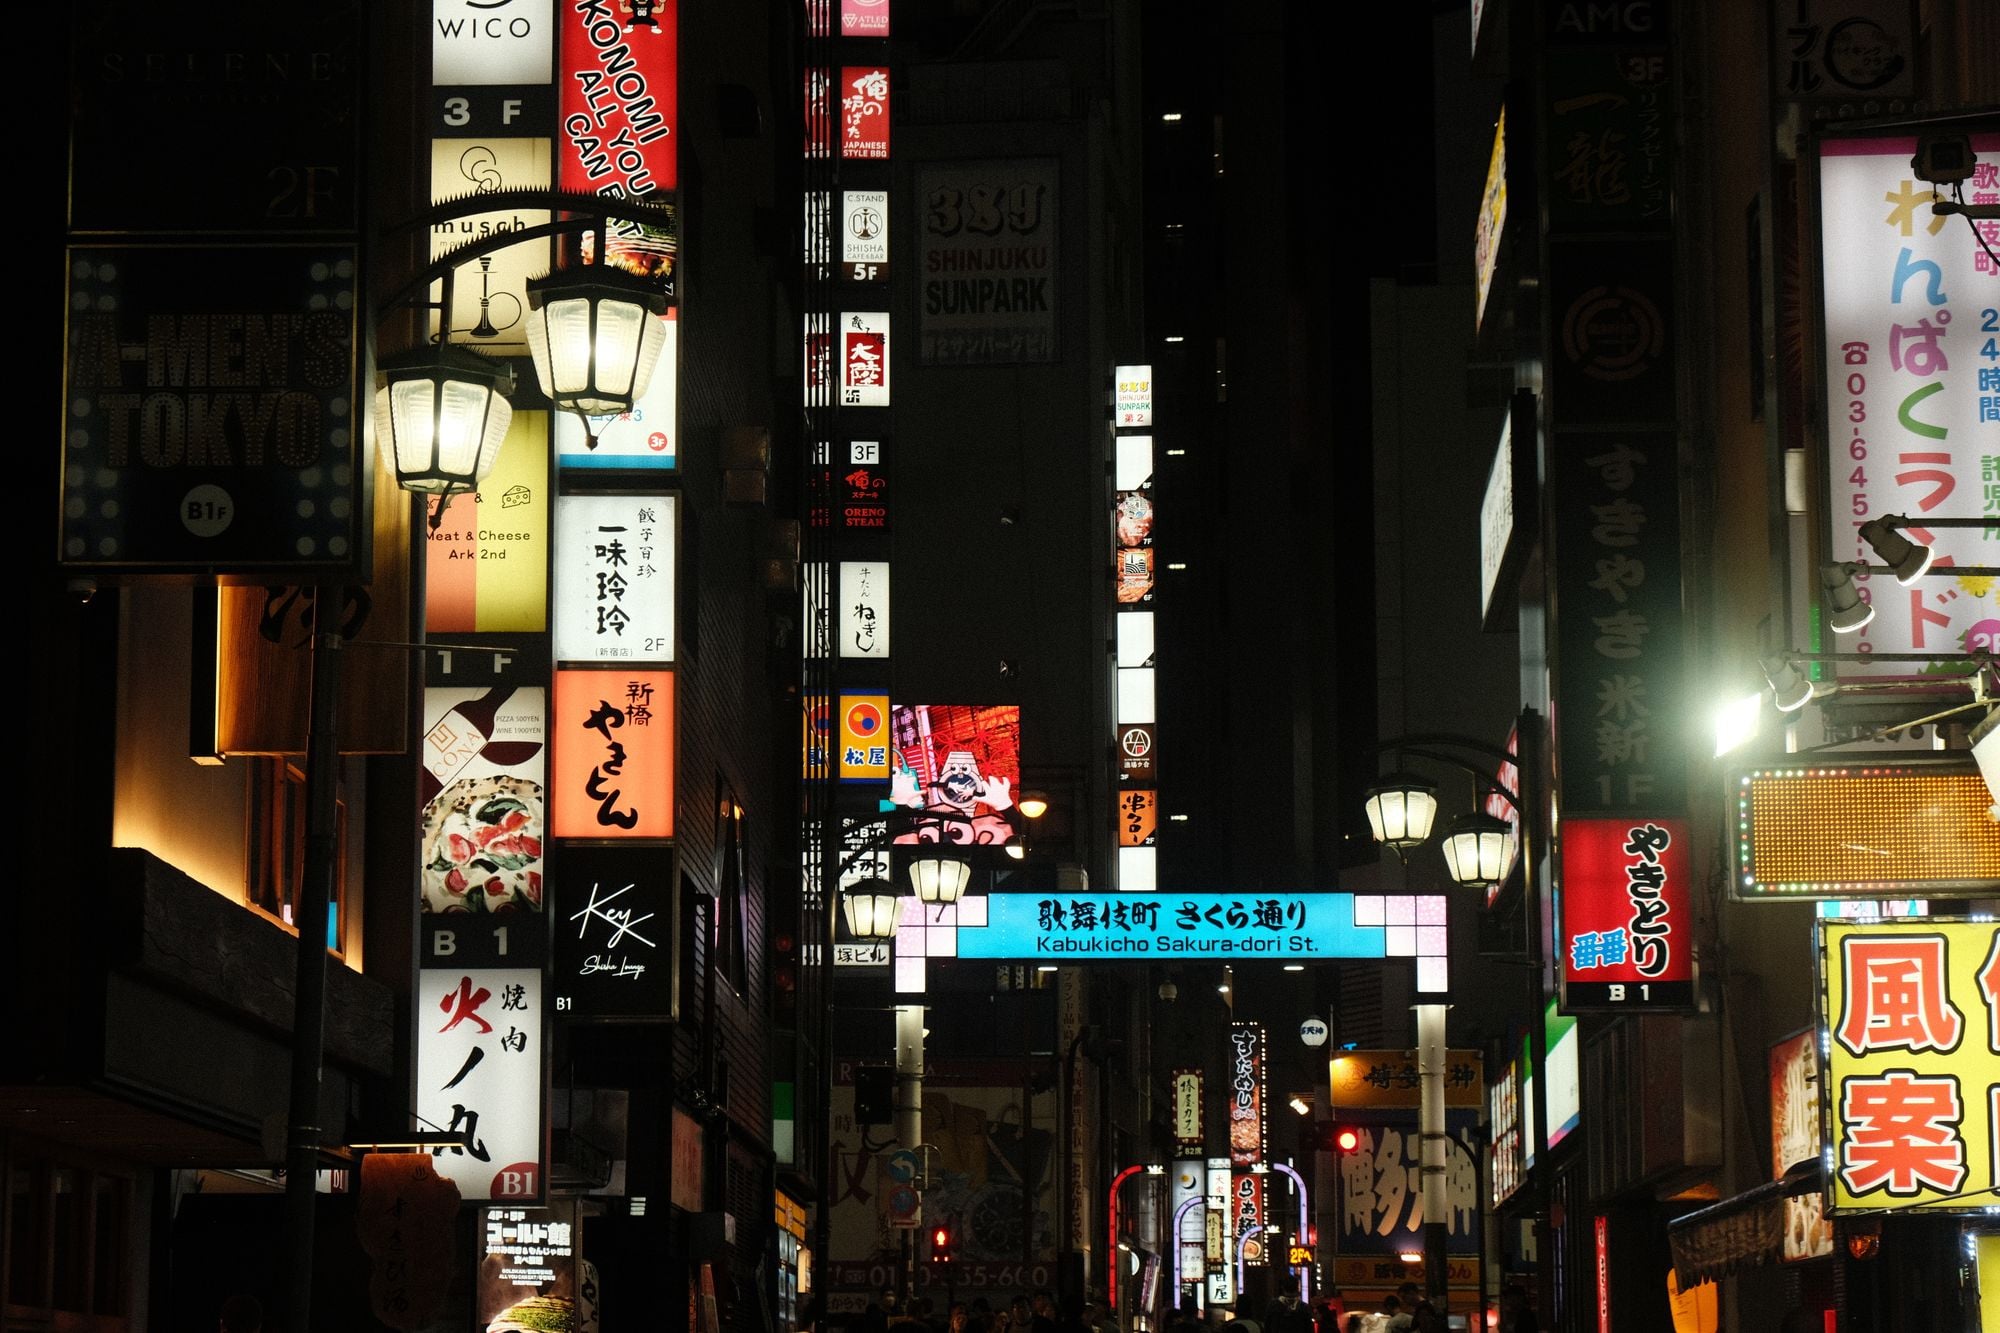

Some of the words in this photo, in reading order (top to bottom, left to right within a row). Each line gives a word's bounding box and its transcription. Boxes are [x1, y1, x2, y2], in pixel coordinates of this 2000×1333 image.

[438, 18, 531, 39] WICO
[1627, 56, 1665, 82] 3F
[576, 70, 617, 128] ALL
[609, 129, 656, 198] YOU
[843, 141, 887, 150] JAPANESE
[843, 149, 868, 158] STYLE
[870, 149, 887, 158] BBQ
[565, 113, 613, 181] CAN
[597, 180, 645, 239] ET
[847, 243, 884, 253] SHISHA
[927, 247, 1047, 273] SHINJUKU
[853, 263, 878, 281] 5F
[926, 277, 1048, 315] SUNPARK
[73, 310, 349, 389] A-MEN'S
[849, 342, 882, 387] 大陸
[1117, 402, 1151, 411] SUNPARK
[1118, 394, 1150, 402] SHINJUKU
[98, 391, 321, 470] TOKYO
[651, 436, 665, 448] 3F
[854, 445, 877, 461] 3F
[845, 469, 886, 489] 俺の
[187, 501, 227, 522] B1F
[845, 508, 886, 517] ORENO
[845, 517, 885, 527] STEAK
[466, 531, 475, 542] &
[478, 530, 531, 542] Cheese
[636, 508, 657, 579] 餃子百珍
[1143, 538, 1152, 546] 7F
[449, 549, 475, 560] Ark
[481, 549, 506, 560] 2nd
[1584, 444, 1650, 660] すきやき
[595, 525, 631, 637] 一味玲玲
[859, 567, 872, 598] 牛たん
[853, 603, 877, 653] ねぎし
[644, 638, 665, 651] 2F
[625, 681, 654, 727] 新橋
[1595, 675, 1650, 766] 米新
[432, 729, 482, 779] CONA
[583, 700, 638, 829] やきとん
[844, 747, 887, 766] 松屋
[1594, 774, 1656, 807] 1F
[569, 882, 656, 949] Key
[1038, 900, 1160, 931] 歌舞伎町
[1175, 900, 1307, 931] さくら通り
[1623, 823, 1671, 977] やきとり
[1038, 936, 1149, 952] Kabukicho
[1157, 935, 1281, 952] Sakura-dori
[1289, 936, 1319, 952] St.
[1571, 927, 1628, 971] 番番
[556, 996, 573, 1011] B1
[1835, 932, 2000, 1060] 風
[500, 983, 528, 1053] 焼肉
[431, 975, 495, 1163] 火ノ丸
[1838, 1069, 2000, 1200] 案
[500, 1171, 535, 1197] B1
